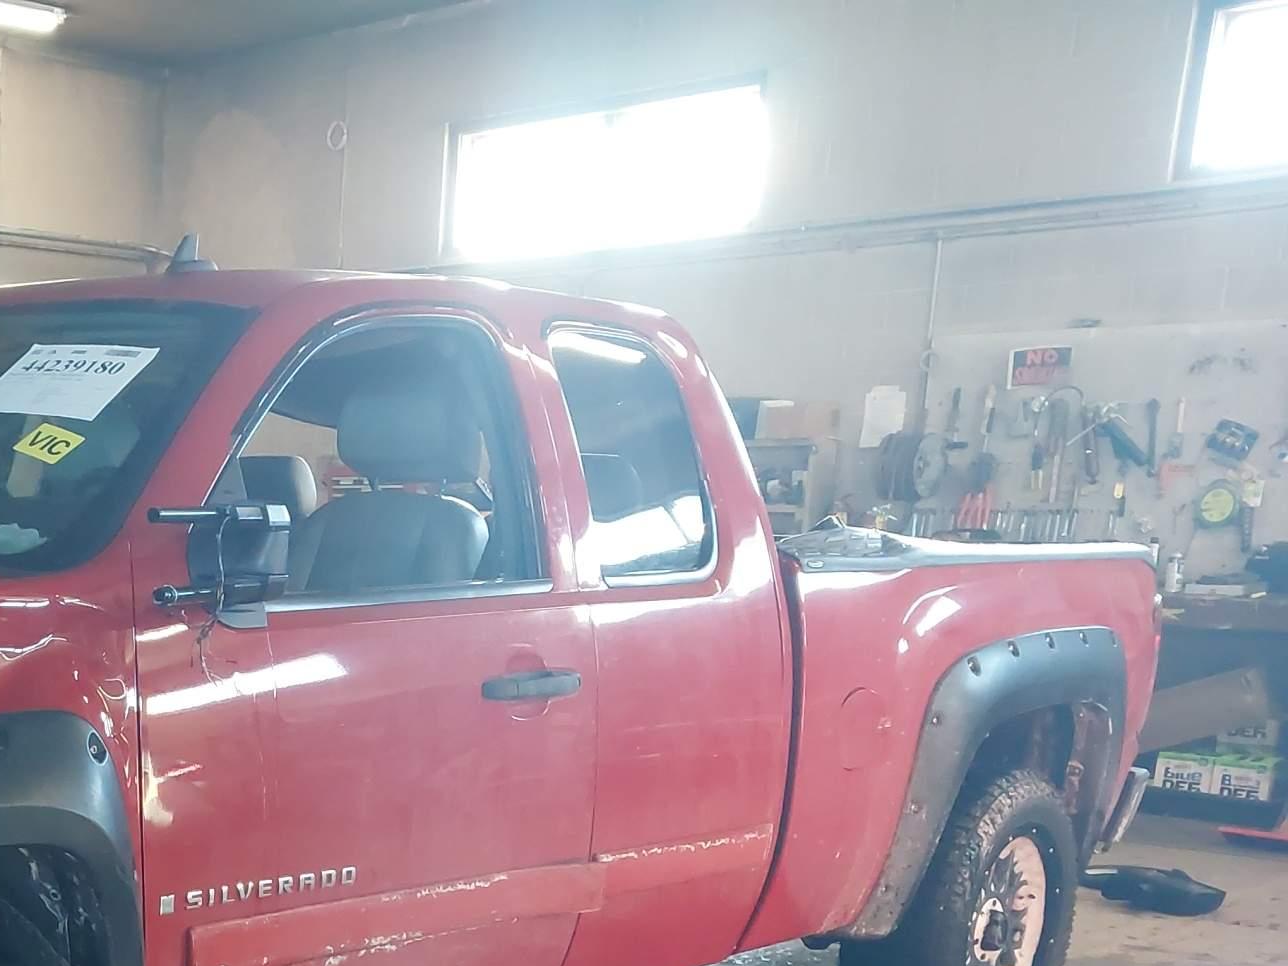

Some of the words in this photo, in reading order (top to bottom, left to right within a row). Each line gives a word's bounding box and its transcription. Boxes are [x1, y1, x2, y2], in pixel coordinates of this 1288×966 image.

[21, 359, 127, 375] 44239180
[1026, 350, 1058, 365] NO
[28, 431, 71, 456] VIC
[185, 866, 358, 910] SILVERADO
